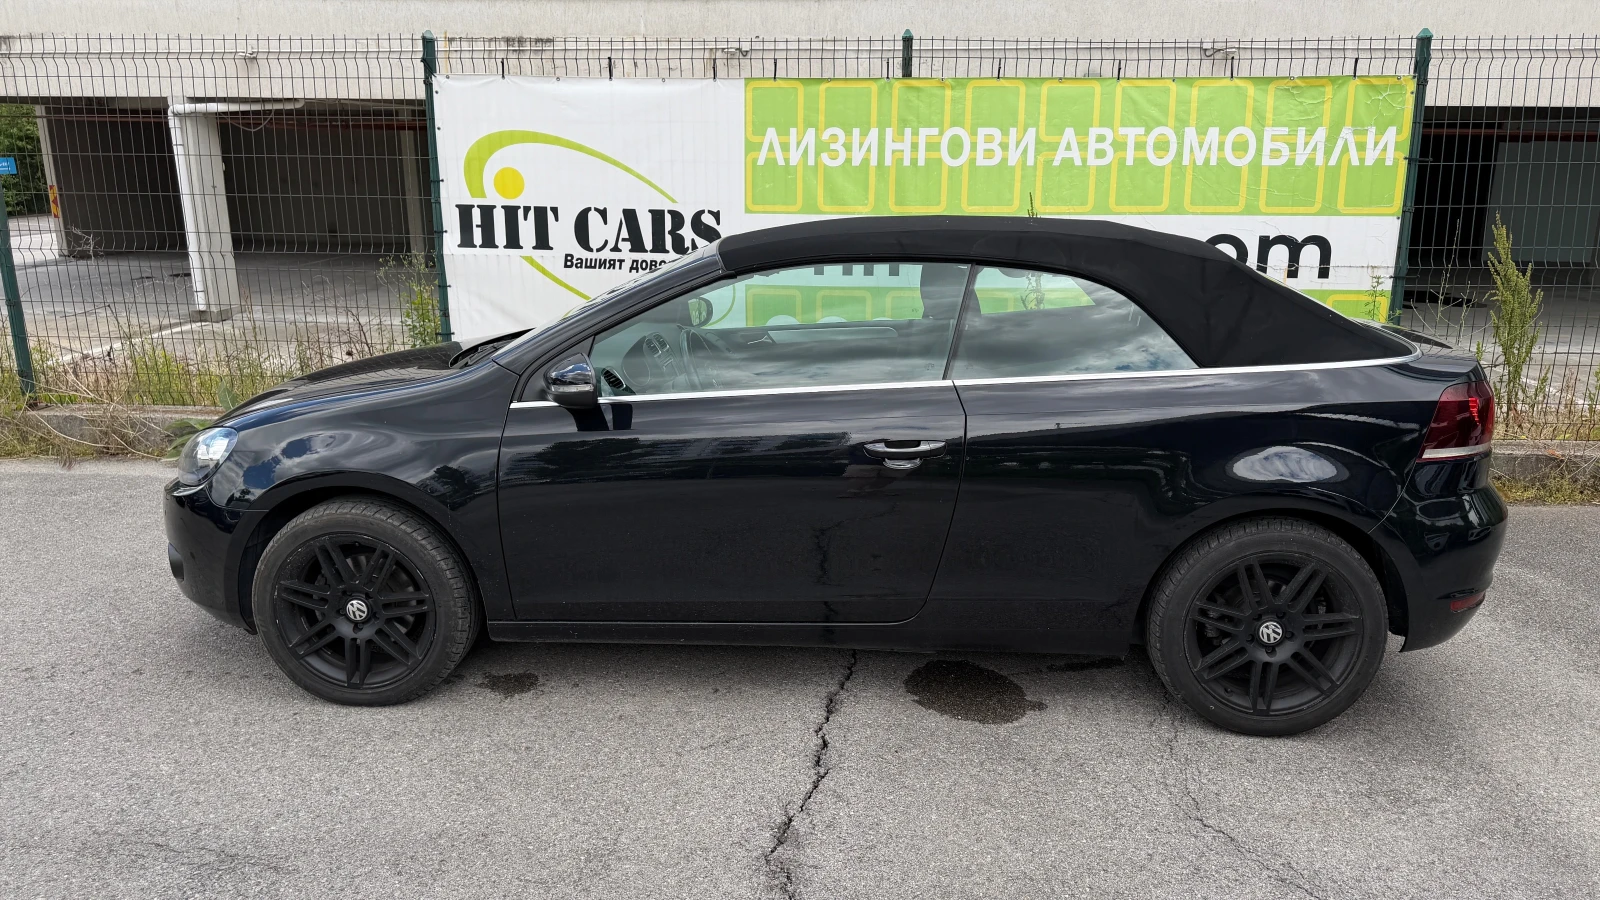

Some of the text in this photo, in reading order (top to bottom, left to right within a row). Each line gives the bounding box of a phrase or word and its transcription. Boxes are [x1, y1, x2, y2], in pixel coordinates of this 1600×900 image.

[757, 125, 1397, 167] ЛИЗИНГОВИ АВТОМОБИЛИ
[455, 204, 722, 255] HIT CARS
[563, 253, 625, 271] Вашият
